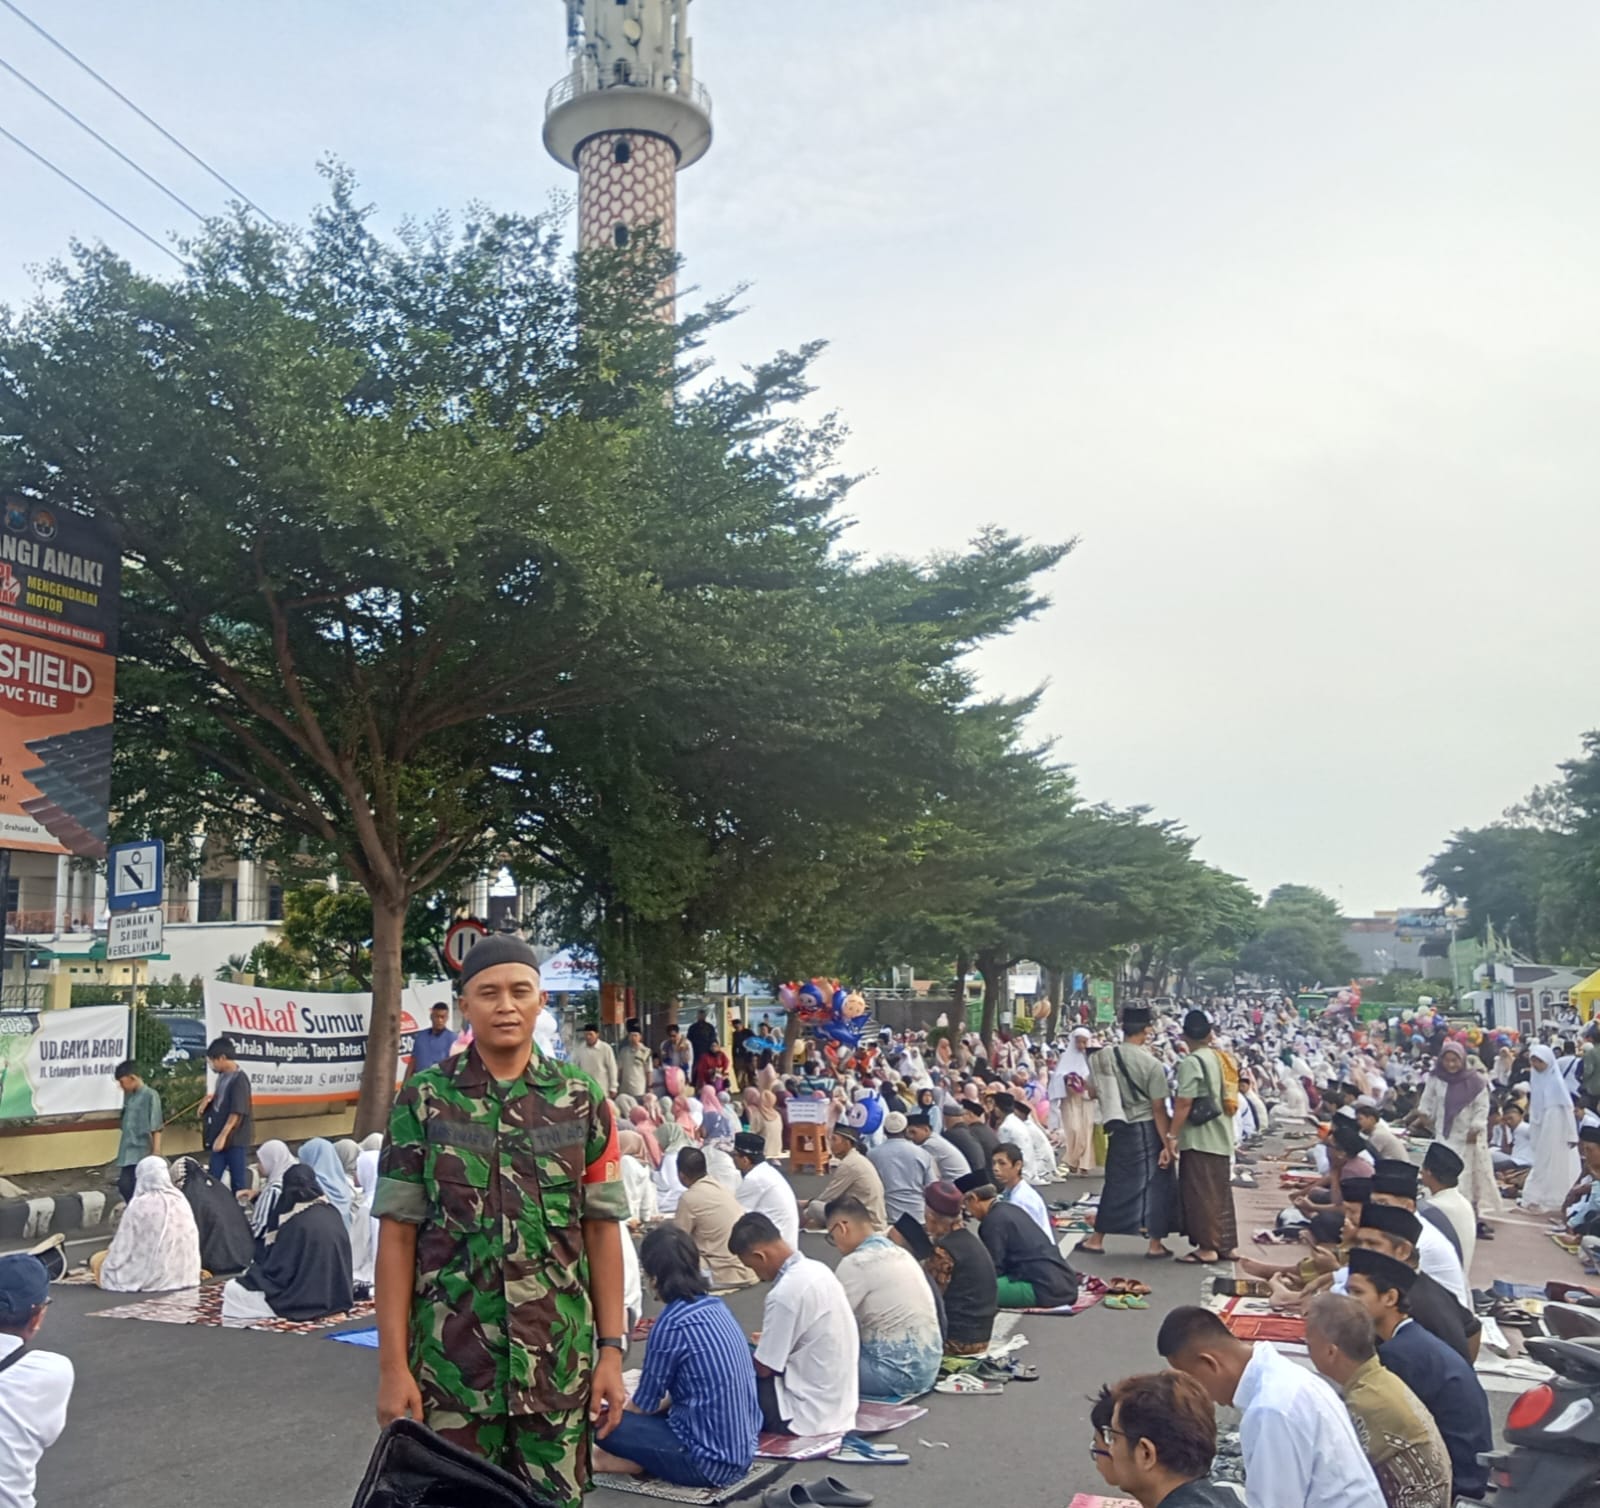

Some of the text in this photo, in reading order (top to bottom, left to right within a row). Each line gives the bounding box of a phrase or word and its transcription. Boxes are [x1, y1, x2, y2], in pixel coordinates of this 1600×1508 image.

[0, 534, 103, 587] NGI ANAK!
[27, 575, 98, 607] MENGENDARAI
[26, 591, 63, 613] MOTOR
[0, 643, 92, 695] SHIELD
[28, 689, 57, 708] TILE
[115, 914, 154, 929] GUNAKAN
[120, 928, 148, 941] SABUK
[220, 997, 364, 1033] wakaf Sumur
[91, 1038, 124, 1058] BARU
[265, 1041, 310, 1061] Mengalir,
[311, 1043, 337, 1061] Tanpa
[339, 1042, 362, 1057] Batas
